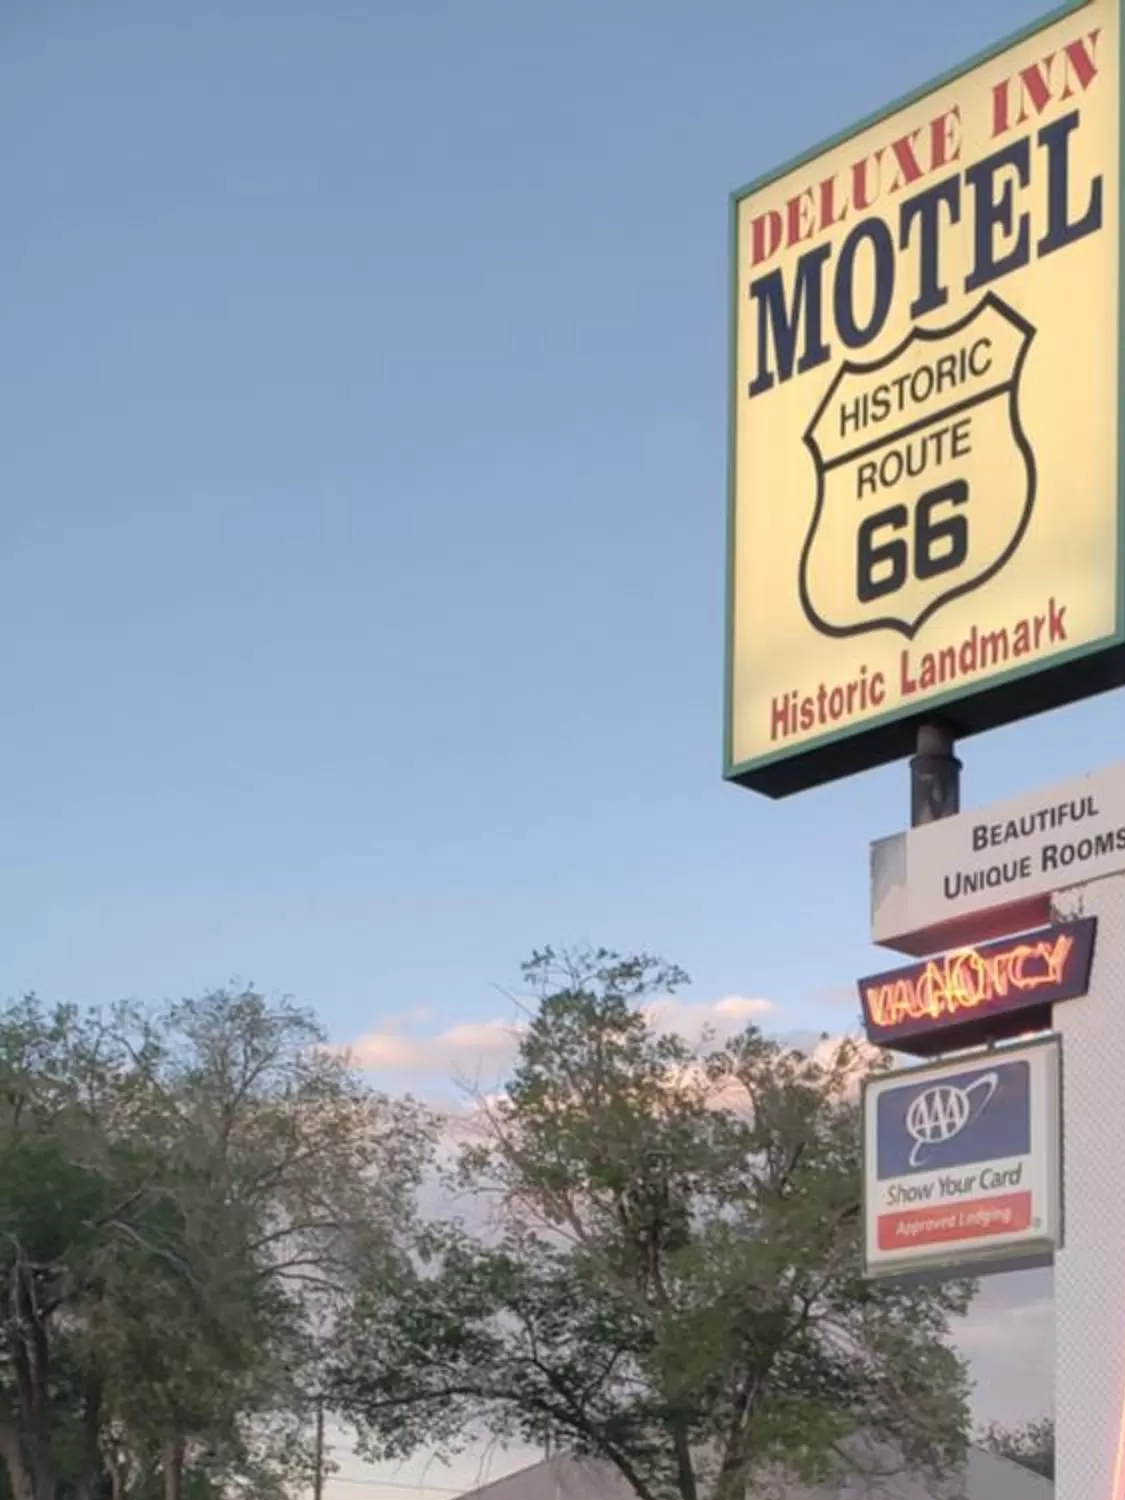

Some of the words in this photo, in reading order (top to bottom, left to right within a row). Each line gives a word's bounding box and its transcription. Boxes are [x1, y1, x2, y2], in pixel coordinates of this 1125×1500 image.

[750, 105, 962, 268] DELUXE
[990, 28, 1102, 139] INN
[748, 109, 1103, 398] MOTEL
[839, 337, 992, 437] HISTORIC
[856, 418, 972, 499] ROUTE
[856, 478, 969, 604] 66
[770, 665, 886, 741] Historic
[900, 597, 1067, 695] Landmark
[972, 795, 1099, 852] BEAUTIFUL
[944, 856, 1031, 900] UNIQUE
[914, 1087, 963, 1142] AAA
[887, 1184, 933, 1207] Show
[938, 1175, 976, 1197] Your
[979, 1162, 1023, 1190] Card
